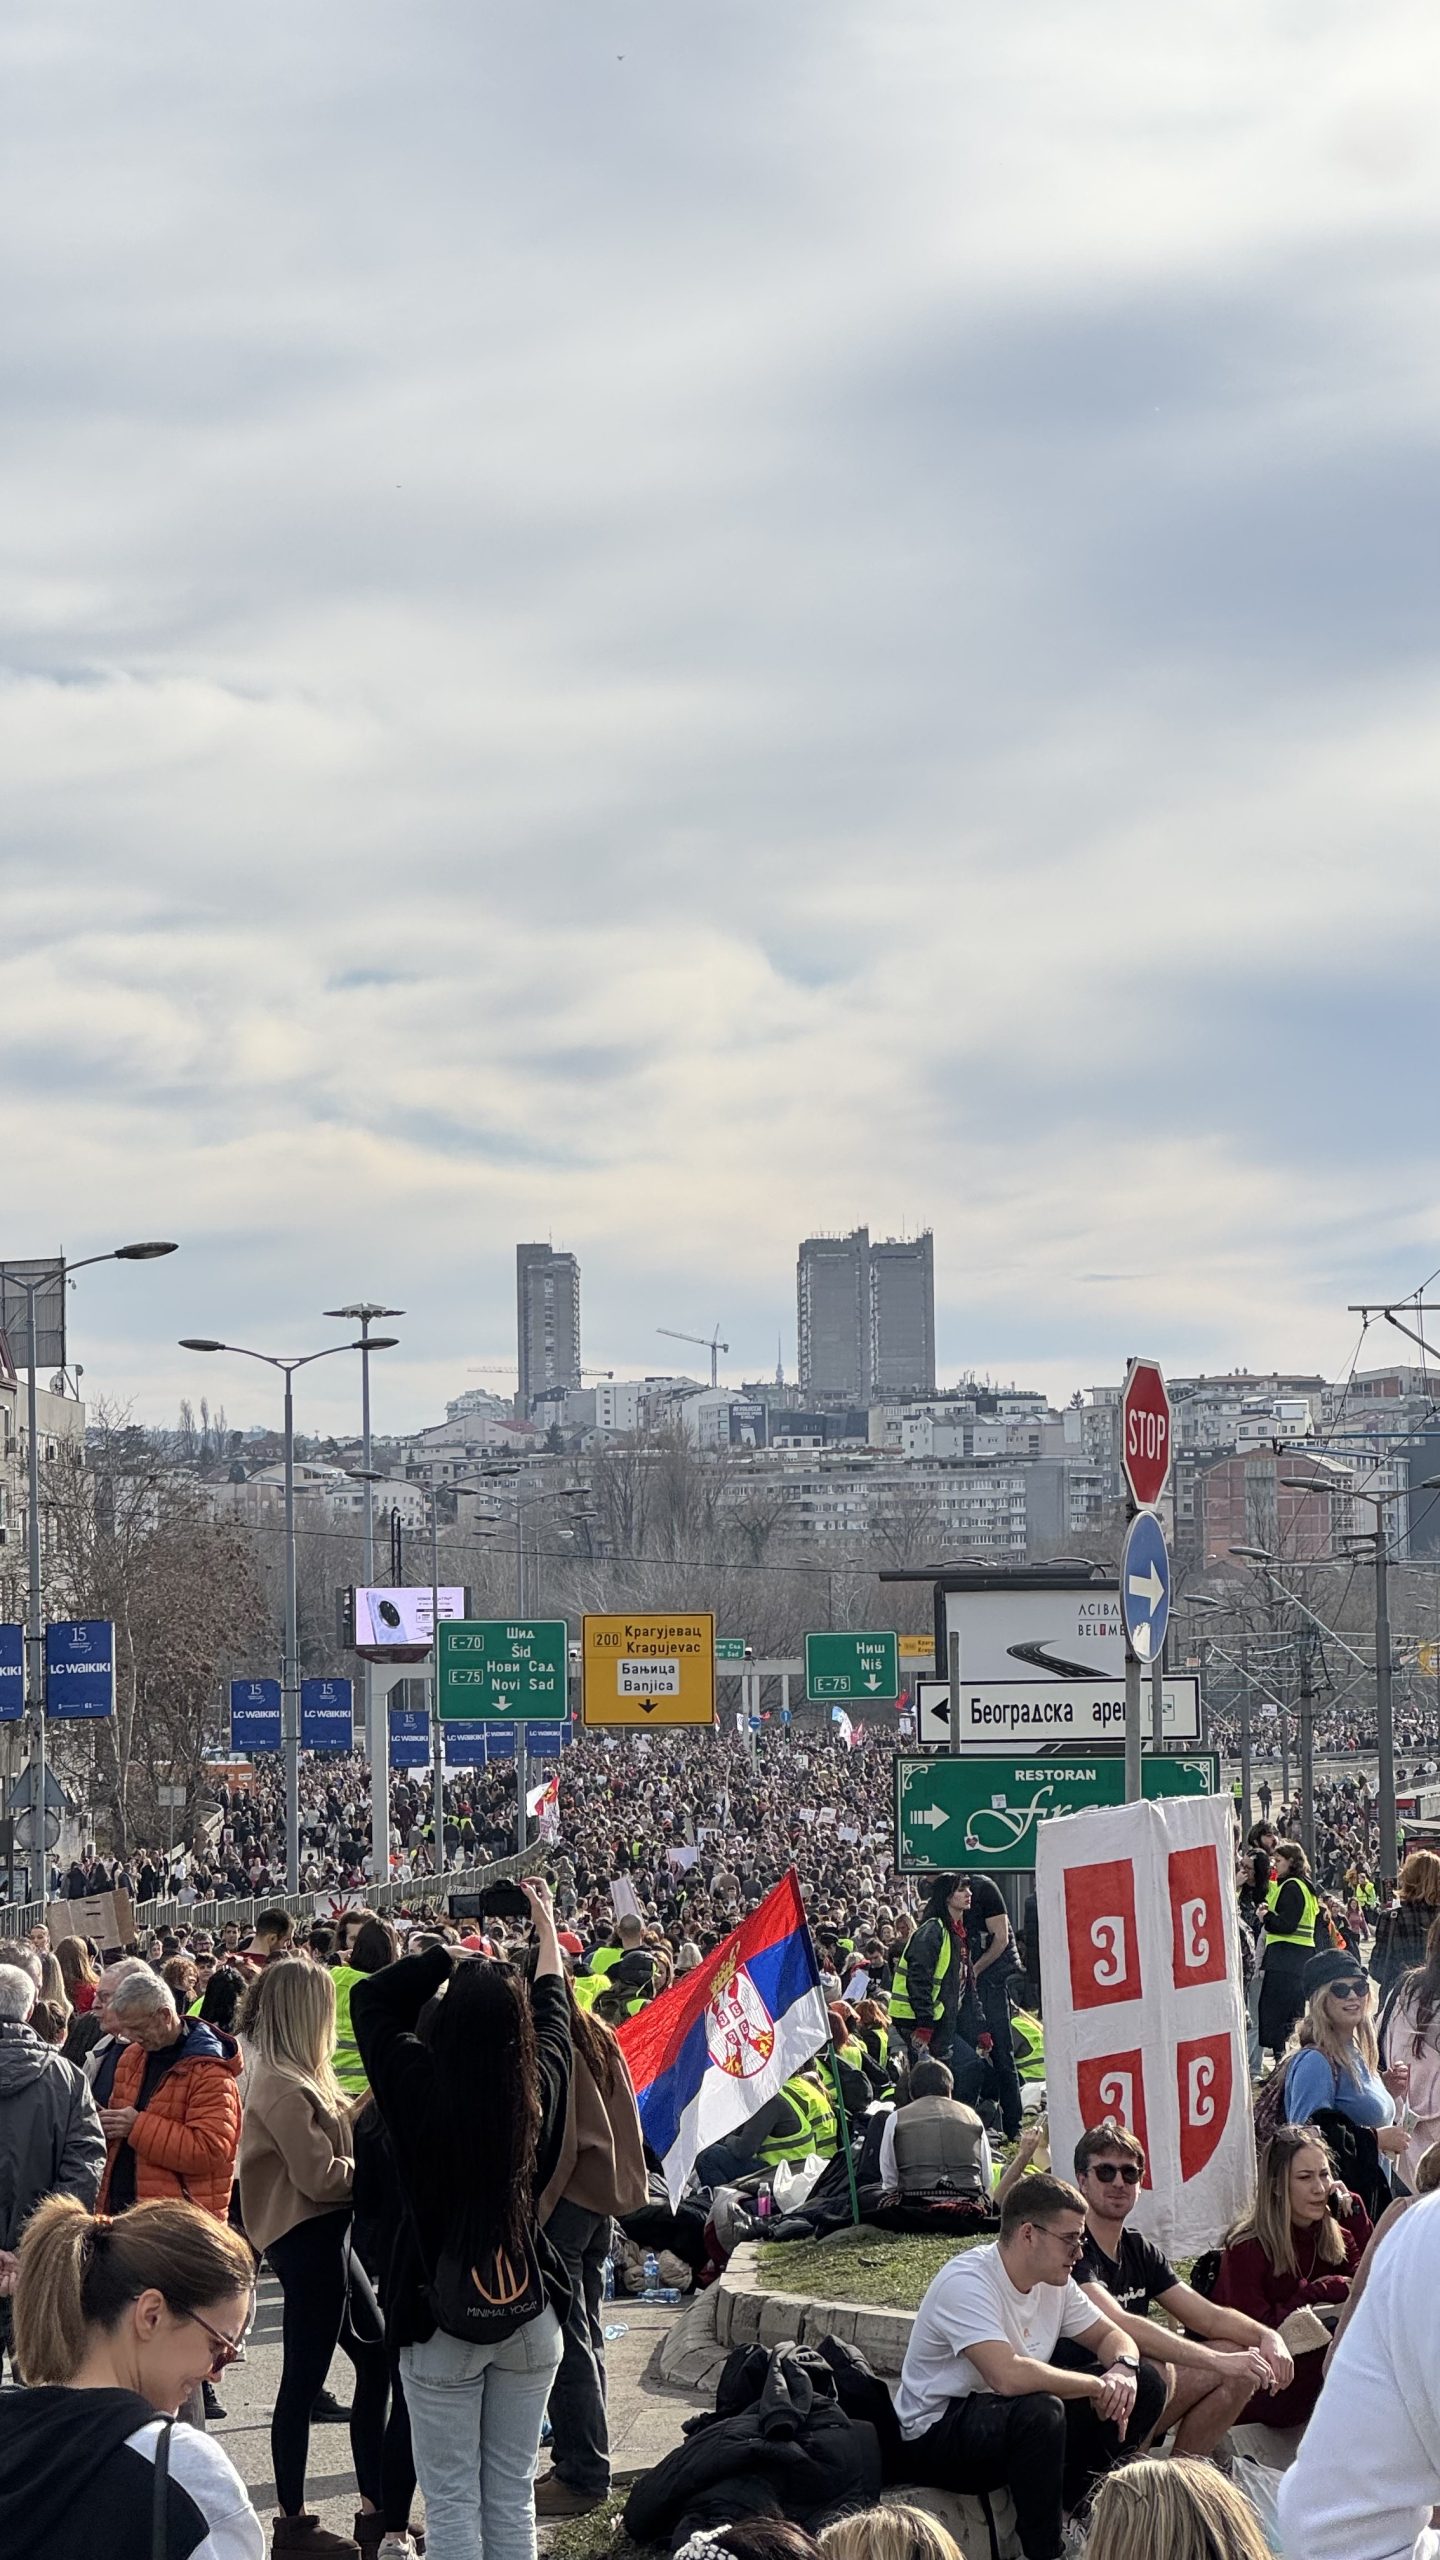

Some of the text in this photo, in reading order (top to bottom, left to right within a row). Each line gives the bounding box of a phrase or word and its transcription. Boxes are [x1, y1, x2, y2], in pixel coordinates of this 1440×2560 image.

[1128, 1408, 1166, 1460] STOP
[1078, 1603, 1119, 1616] ACIBA
[71, 1627, 87, 1642] 15
[506, 1627, 536, 1639] Шид
[625, 1625, 702, 1640] Крагујевац
[451, 1637, 481, 1649] E-70
[596, 1634, 619, 1646] 200
[511, 1642, 531, 1658] Šid
[626, 1642, 701, 1656] Kragujevac
[856, 1642, 886, 1654] Ниш
[50, 1664, 65, 1675] LC
[486, 1660, 555, 1673] Нови Сад
[622, 1663, 675, 1675] Бањица
[861, 1658, 882, 1670] Niš
[451, 1671, 481, 1683] E-75
[250, 1684, 262, 1695] 15
[321, 1683, 334, 1695] 15
[491, 1678, 555, 1690] Novi Sad
[624, 1680, 673, 1693] Banjica
[817, 1678, 848, 1690] E-75
[233, 1710, 245, 1719] LC
[304, 1710, 316, 1718] LC
[405, 1714, 414, 1723] 15
[971, 1698, 1126, 1730] Београдска аре
[447, 1734, 457, 1742] LC
[1015, 1769, 1097, 1781] RESTORAN
[466, 2307, 505, 2317] MINIMAL
